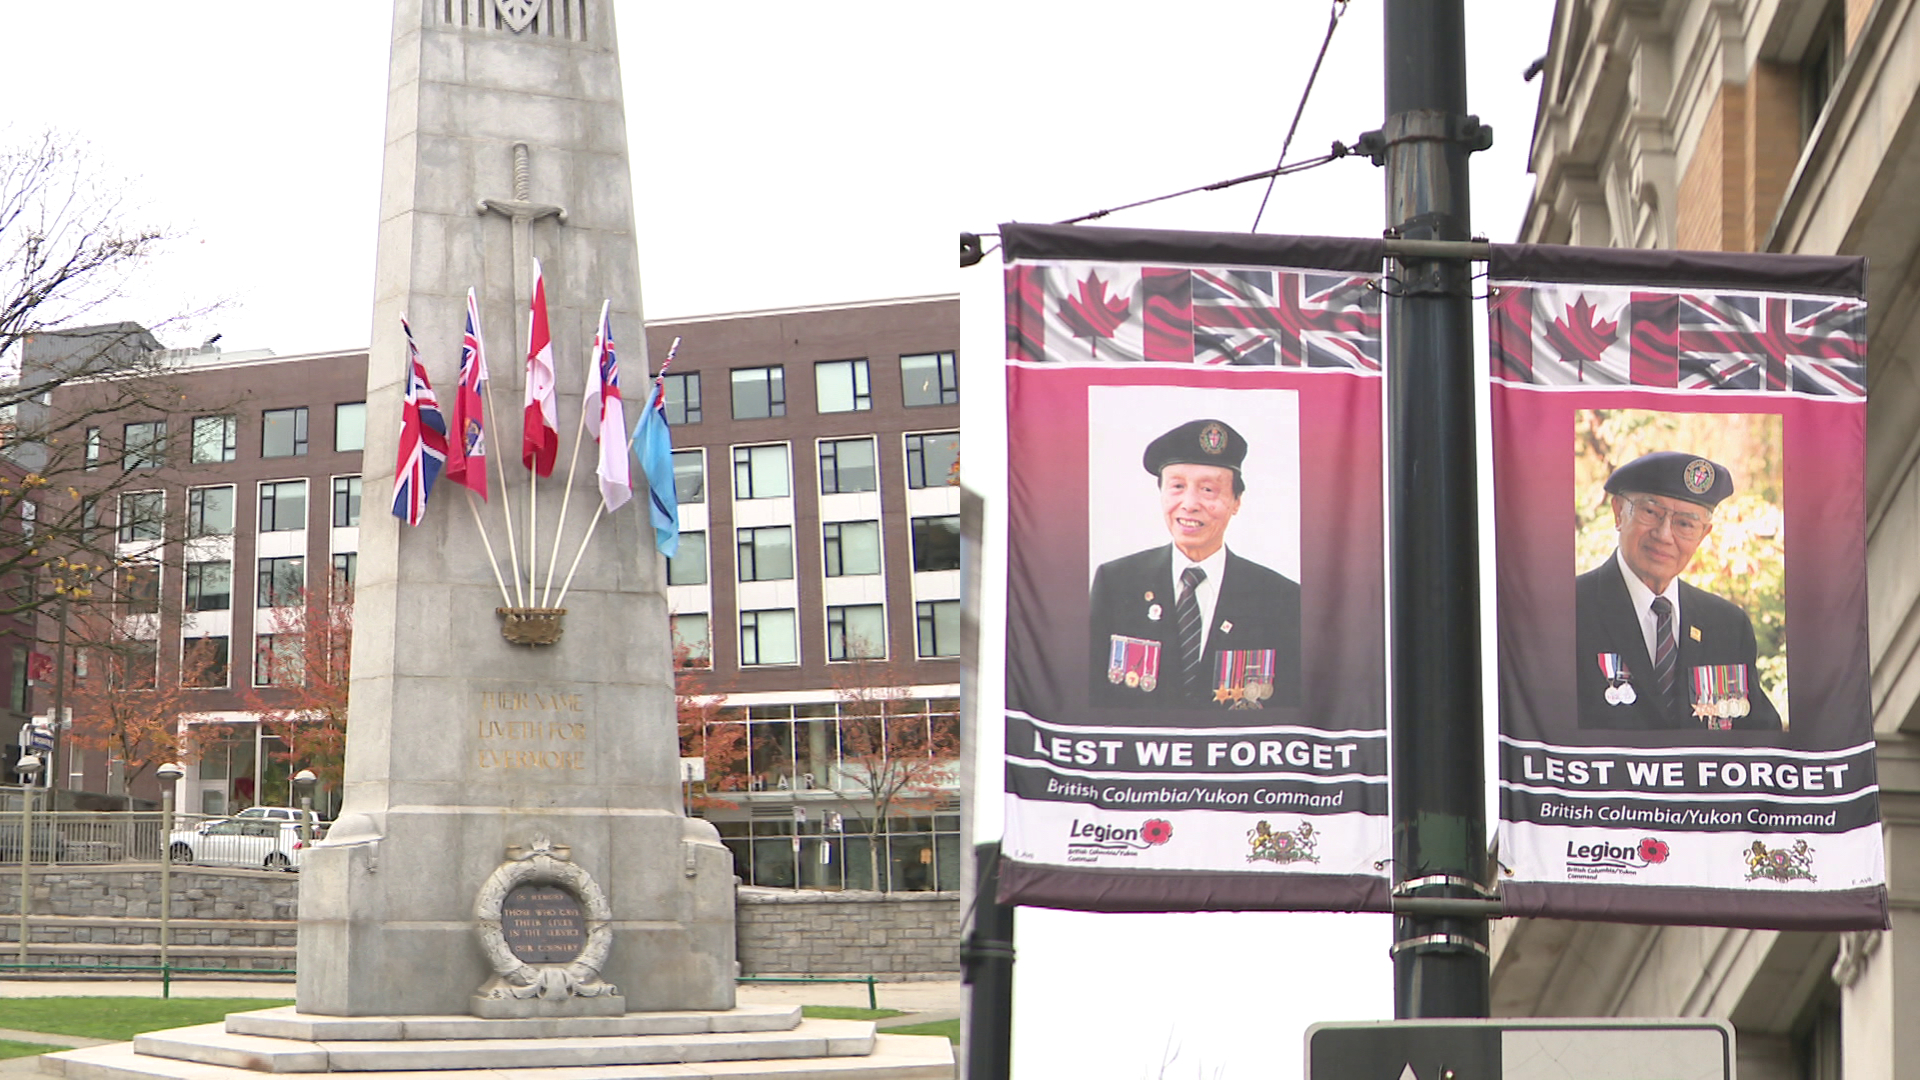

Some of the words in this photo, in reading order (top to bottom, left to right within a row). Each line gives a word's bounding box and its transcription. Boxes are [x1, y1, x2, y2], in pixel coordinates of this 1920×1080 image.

[478, 720, 543, 739] LIVETH
[549, 721, 587, 741] FOR
[478, 749, 586, 770] EVERMORE
[1034, 729, 1123, 766] LEST
[1135, 741, 1193, 767] WE
[1207, 739, 1358, 770] FORGET
[1523, 754, 1615, 785] LEST
[1626, 761, 1685, 787] WE
[1697, 760, 1849, 791] FORGET
[1047, 778, 1099, 799] British
[1102, 786, 1249, 806] Columbia/Yukon
[1252, 788, 1344, 807] Command
[1540, 802, 1593, 820] British
[1597, 806, 1742, 826] Columbia/Yukon
[1747, 808, 1837, 827] Command
[1069, 818, 1139, 846] Legion
[1566, 840, 1636, 862] Legion
